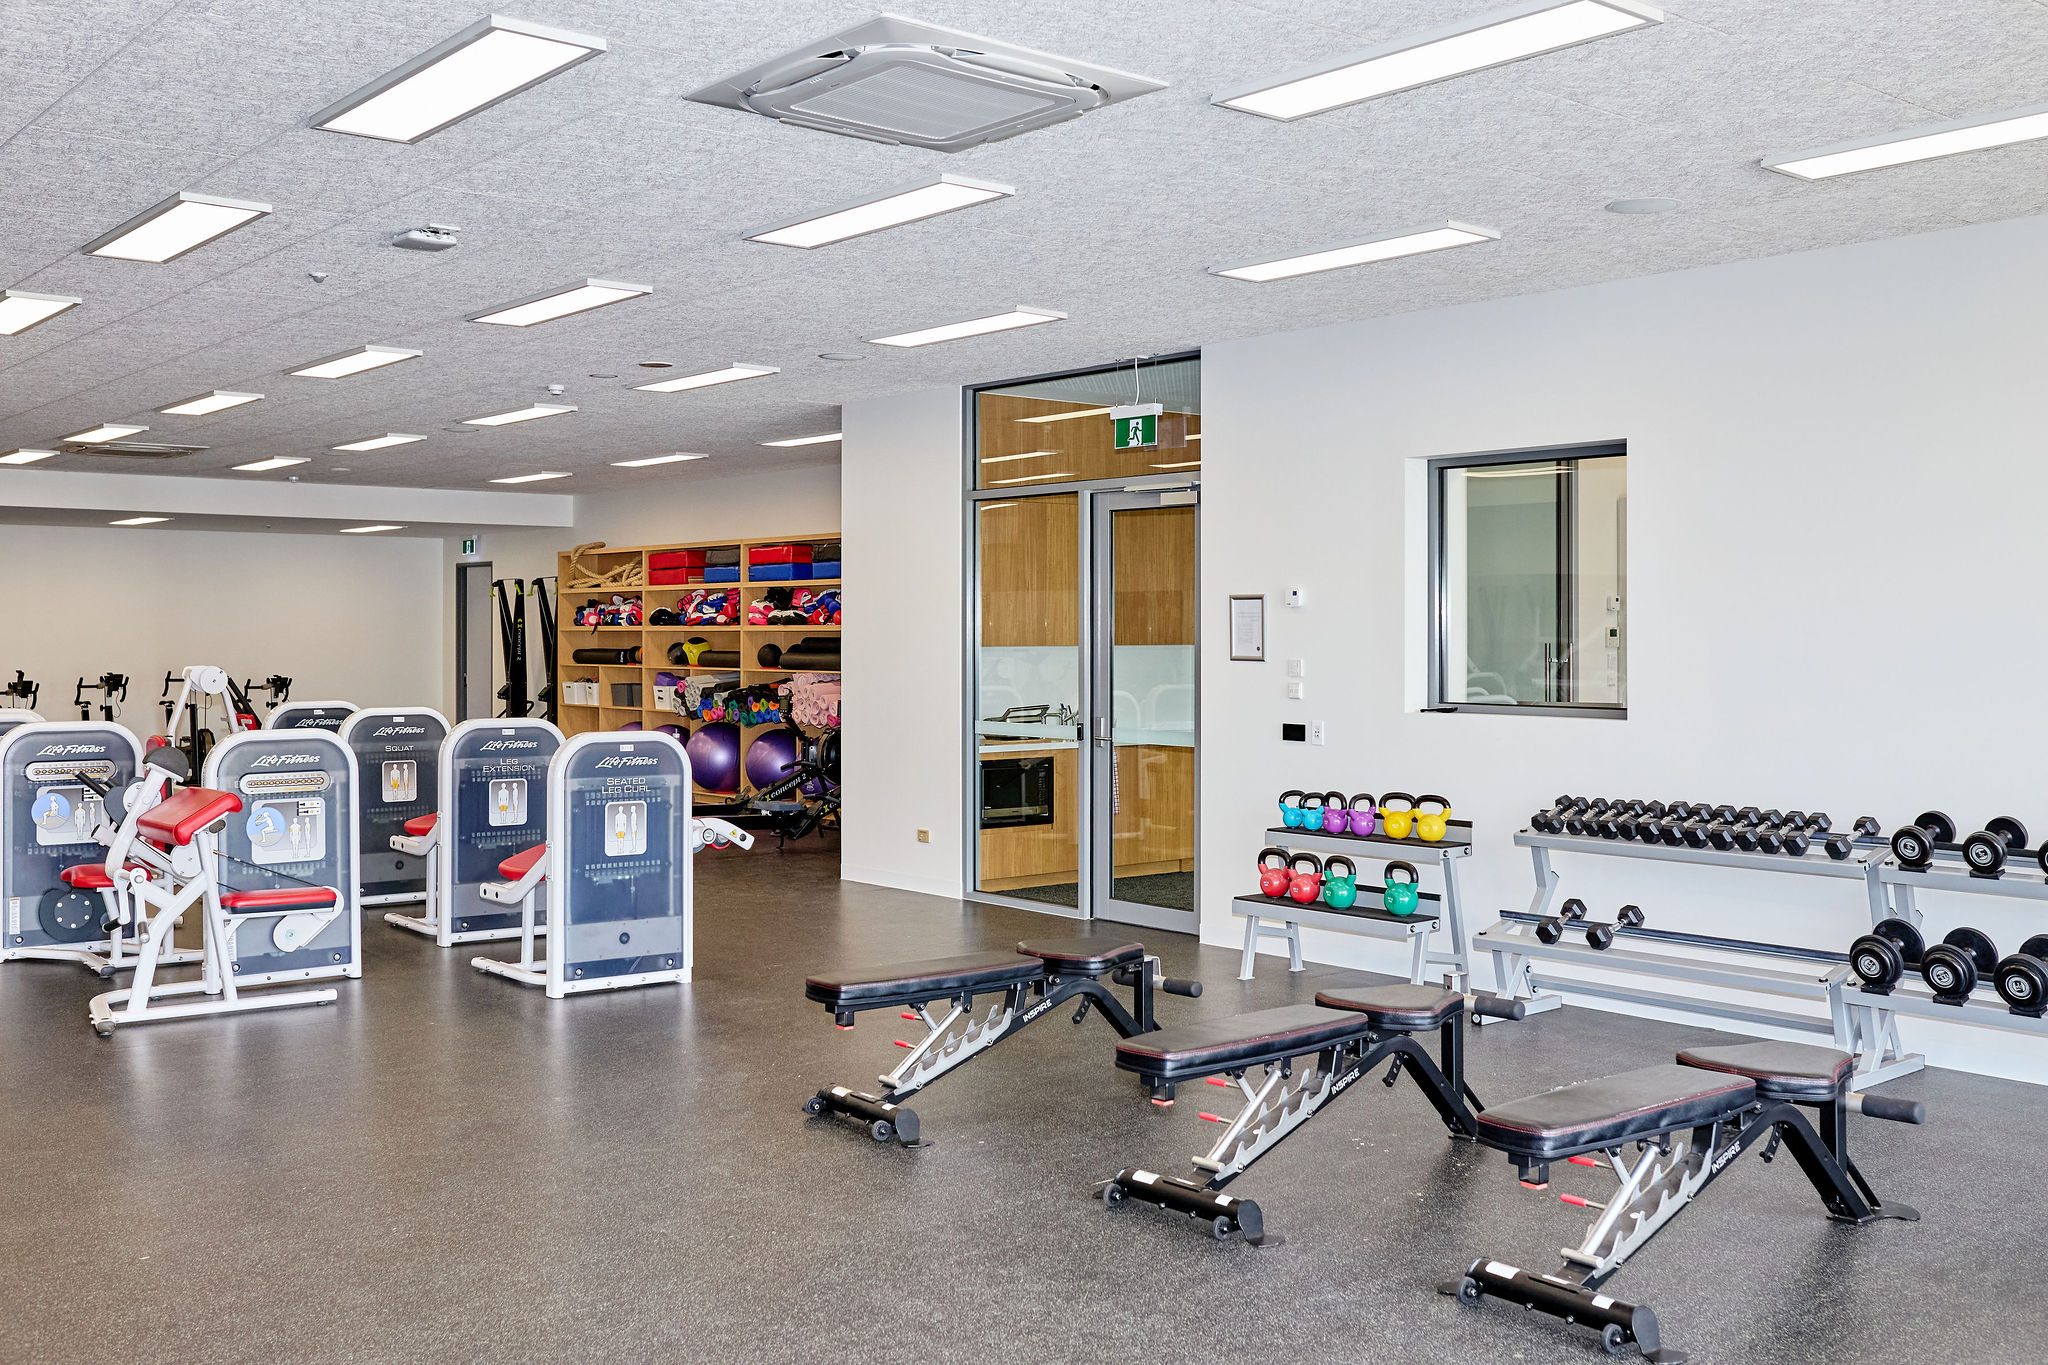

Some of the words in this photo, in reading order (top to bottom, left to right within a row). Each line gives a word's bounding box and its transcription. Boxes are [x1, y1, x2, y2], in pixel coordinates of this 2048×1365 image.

[294, 718, 314, 728] Life
[373, 726, 394, 737] Life
[391, 726, 425, 736] Fitness
[36, 744, 64, 756] Life
[62, 744, 106, 756] Fitness
[479, 740, 503, 751] Life
[500, 740, 538, 751] Fitness
[250, 754, 278, 768] Life
[276, 754, 321, 767] Fitness
[595, 756, 620, 769] Life
[618, 756, 659, 768] Fitness
[482, 765, 535, 773] EXTENSION
[606, 777, 646, 786] SEATED
[770, 776, 801, 799] concept
[601, 786, 622, 794] LEG
[624, 785, 651, 793] CURL
[1022, 998, 1052, 1023] INSPIRE
[1331, 1067, 1360, 1095] INSPIRE
[1711, 1140, 1741, 1174] INSPIRE
